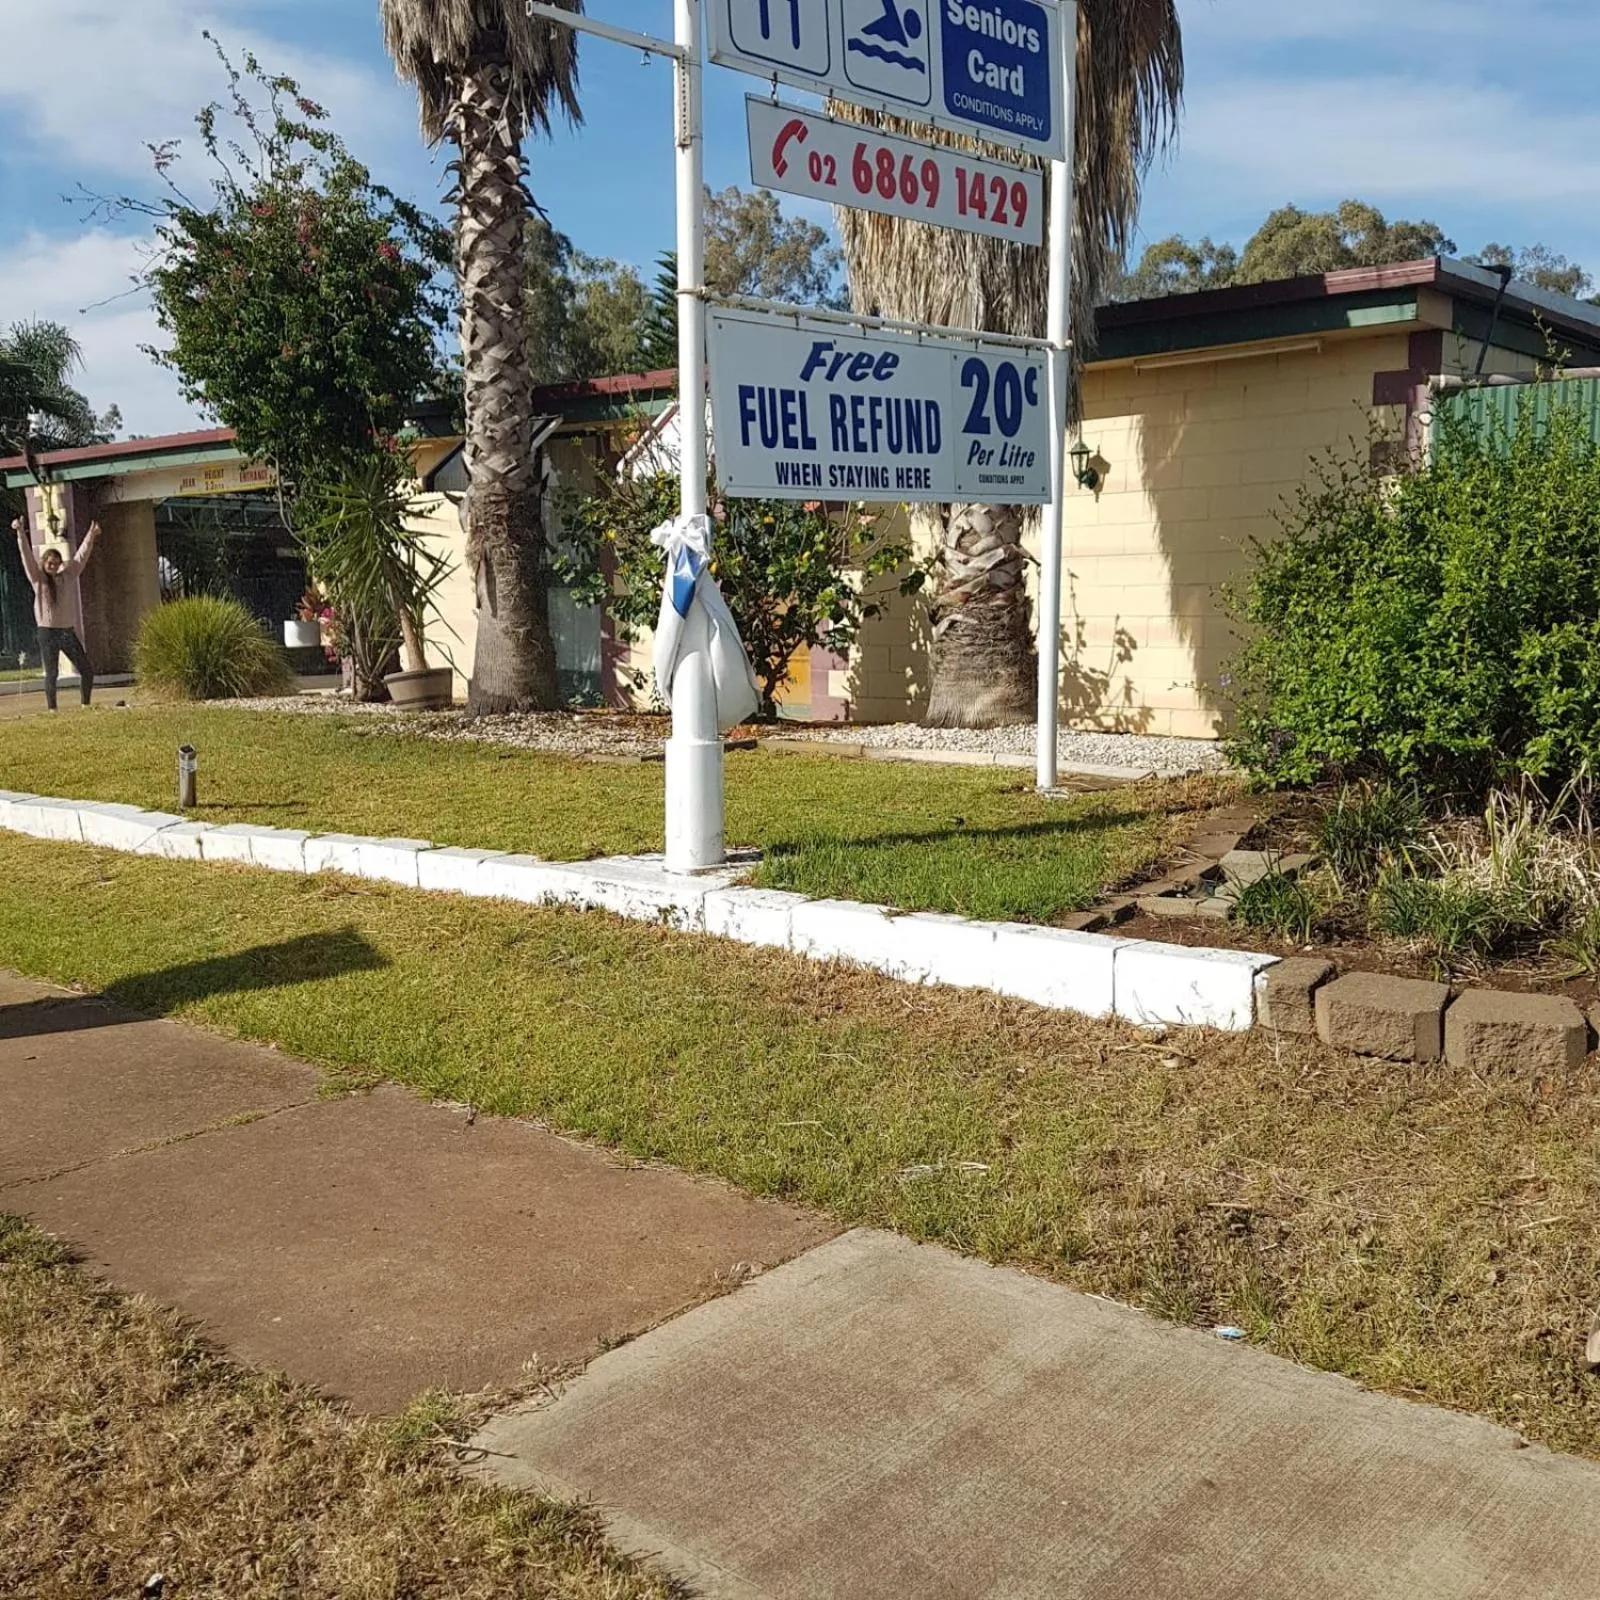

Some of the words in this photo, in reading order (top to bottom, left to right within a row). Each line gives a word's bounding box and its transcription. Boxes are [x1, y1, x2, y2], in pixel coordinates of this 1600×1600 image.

[947, 0, 1040, 53] Seniors
[968, 49, 1024, 97] Card
[953, 92, 1013, 123] CONDITIONS
[1015, 112, 1044, 131] APPLY
[808, 150, 837, 186] 02
[852, 142, 940, 208] 6869
[955, 166, 1028, 228] 1429
[799, 341, 900, 382] Free
[738, 384, 817, 450] FUEL
[829, 393, 942, 454] REFUND
[967, 439, 994, 467] Per
[1000, 441, 1035, 468] Litre
[775, 462, 822, 486] WHEN
[829, 464, 889, 489] STAYING
[896, 466, 932, 490] HERE
